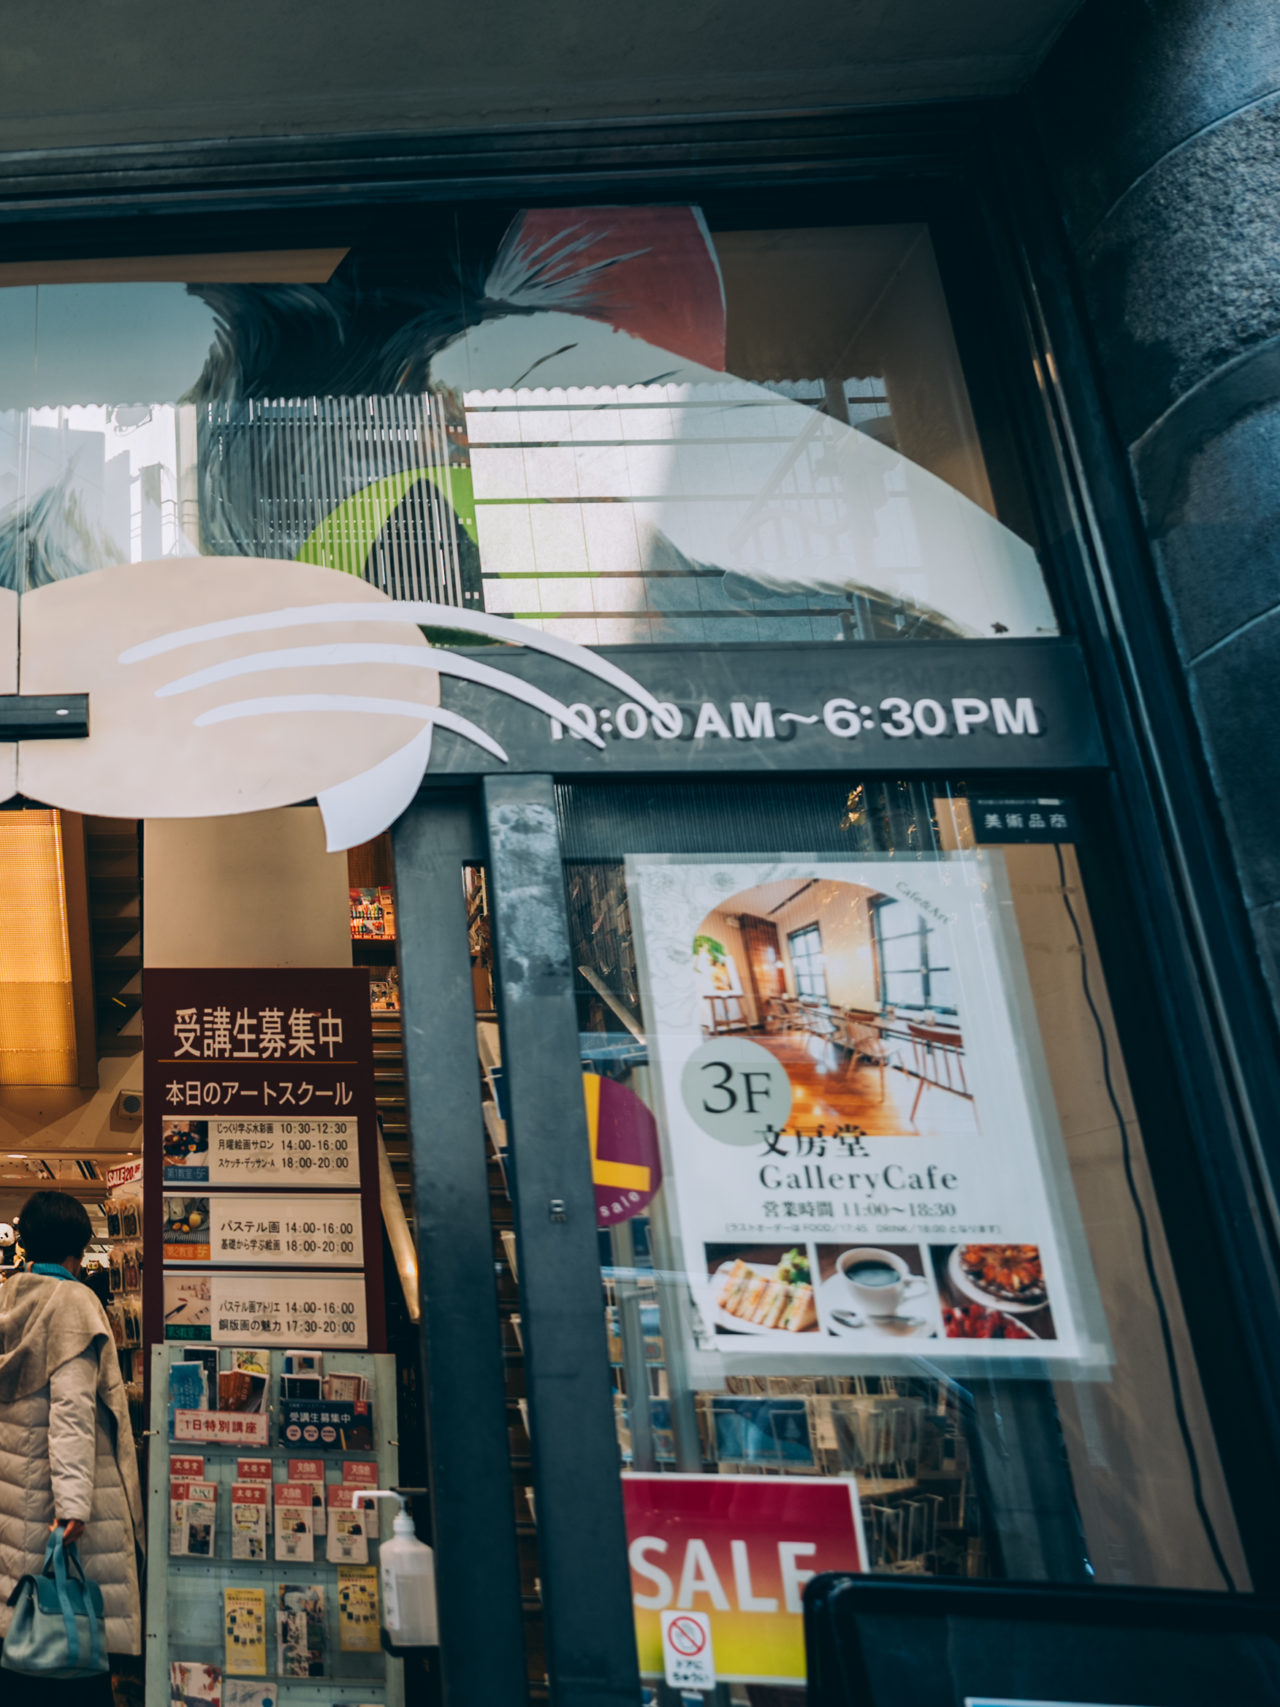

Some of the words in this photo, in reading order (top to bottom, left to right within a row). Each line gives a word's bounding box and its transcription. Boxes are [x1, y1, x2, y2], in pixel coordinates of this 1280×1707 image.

[174, 1006, 344, 1059] 受講生募集中
[165, 1080, 353, 1106] 本日のアートスクール
[700, 1061, 772, 1114] 3F
[216, 1123, 274, 1135] じっくり学ぶ水彩画
[281, 1123, 347, 1135] 10:30-12:30
[218, 1139, 274, 1151] 月曜絵画サロン
[281, 1139, 348, 1151] 14:00-16:00
[754, 1124, 870, 1158] 文房堂
[282, 1157, 349, 1169] 18:00-20:00
[600, 1191, 641, 1217] sale
[763, 1200, 834, 1218] 営業時間
[220, 1220, 280, 1234] パステル画
[285, 1222, 353, 1234] 14:00-16:00
[286, 1240, 354, 1253] 18:00-20:00
[219, 1300, 280, 1314] パステル画アトリエ
[285, 1301, 354, 1314] 14:00-16:00
[286, 1320, 355, 1333] 17:30-20:00
[185, 1418, 257, 1434] 1日特別講座
[628, 1535, 818, 1615] SALE
